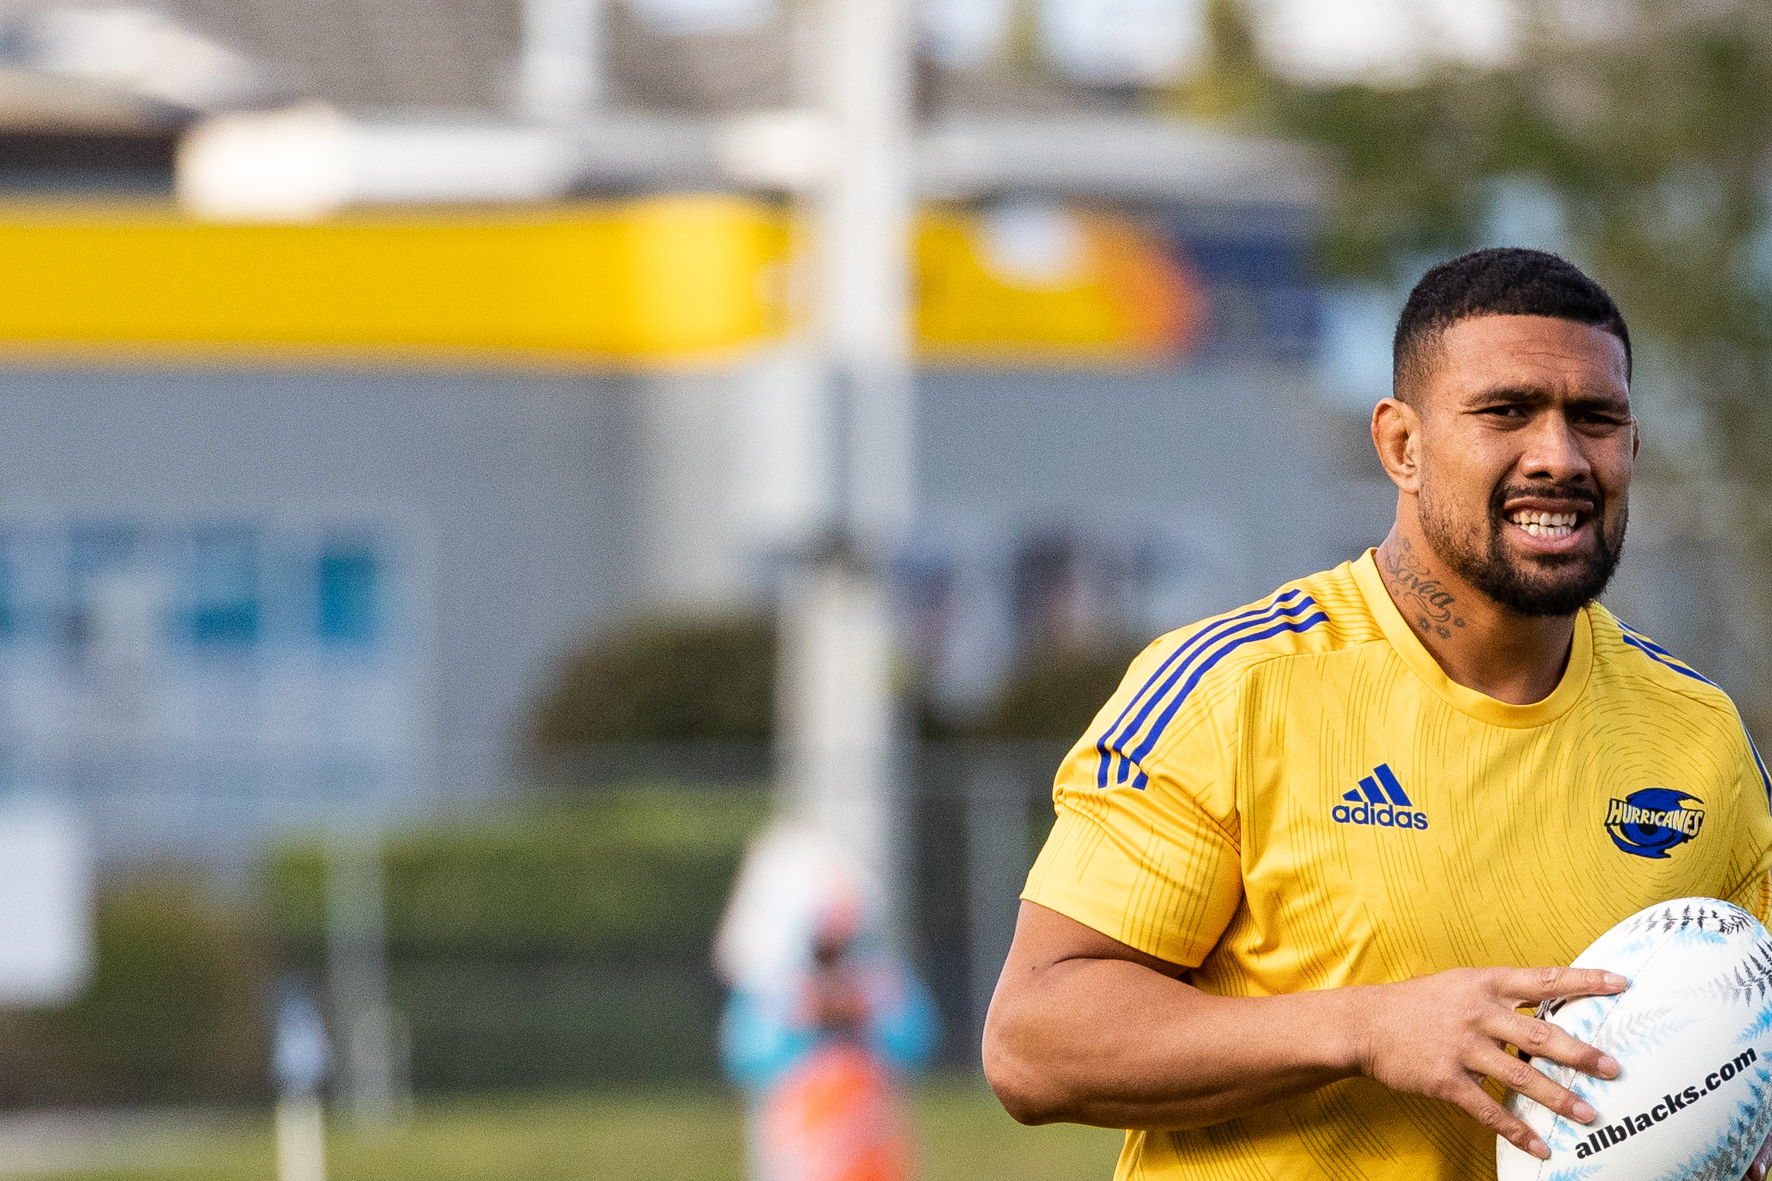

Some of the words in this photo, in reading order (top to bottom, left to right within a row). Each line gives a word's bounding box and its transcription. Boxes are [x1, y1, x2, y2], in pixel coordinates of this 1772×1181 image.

[1331, 800, 1429, 831] adidas
[1606, 799, 1704, 837] HURRICANES
[1575, 1046, 1757, 1160] allblacks.com
